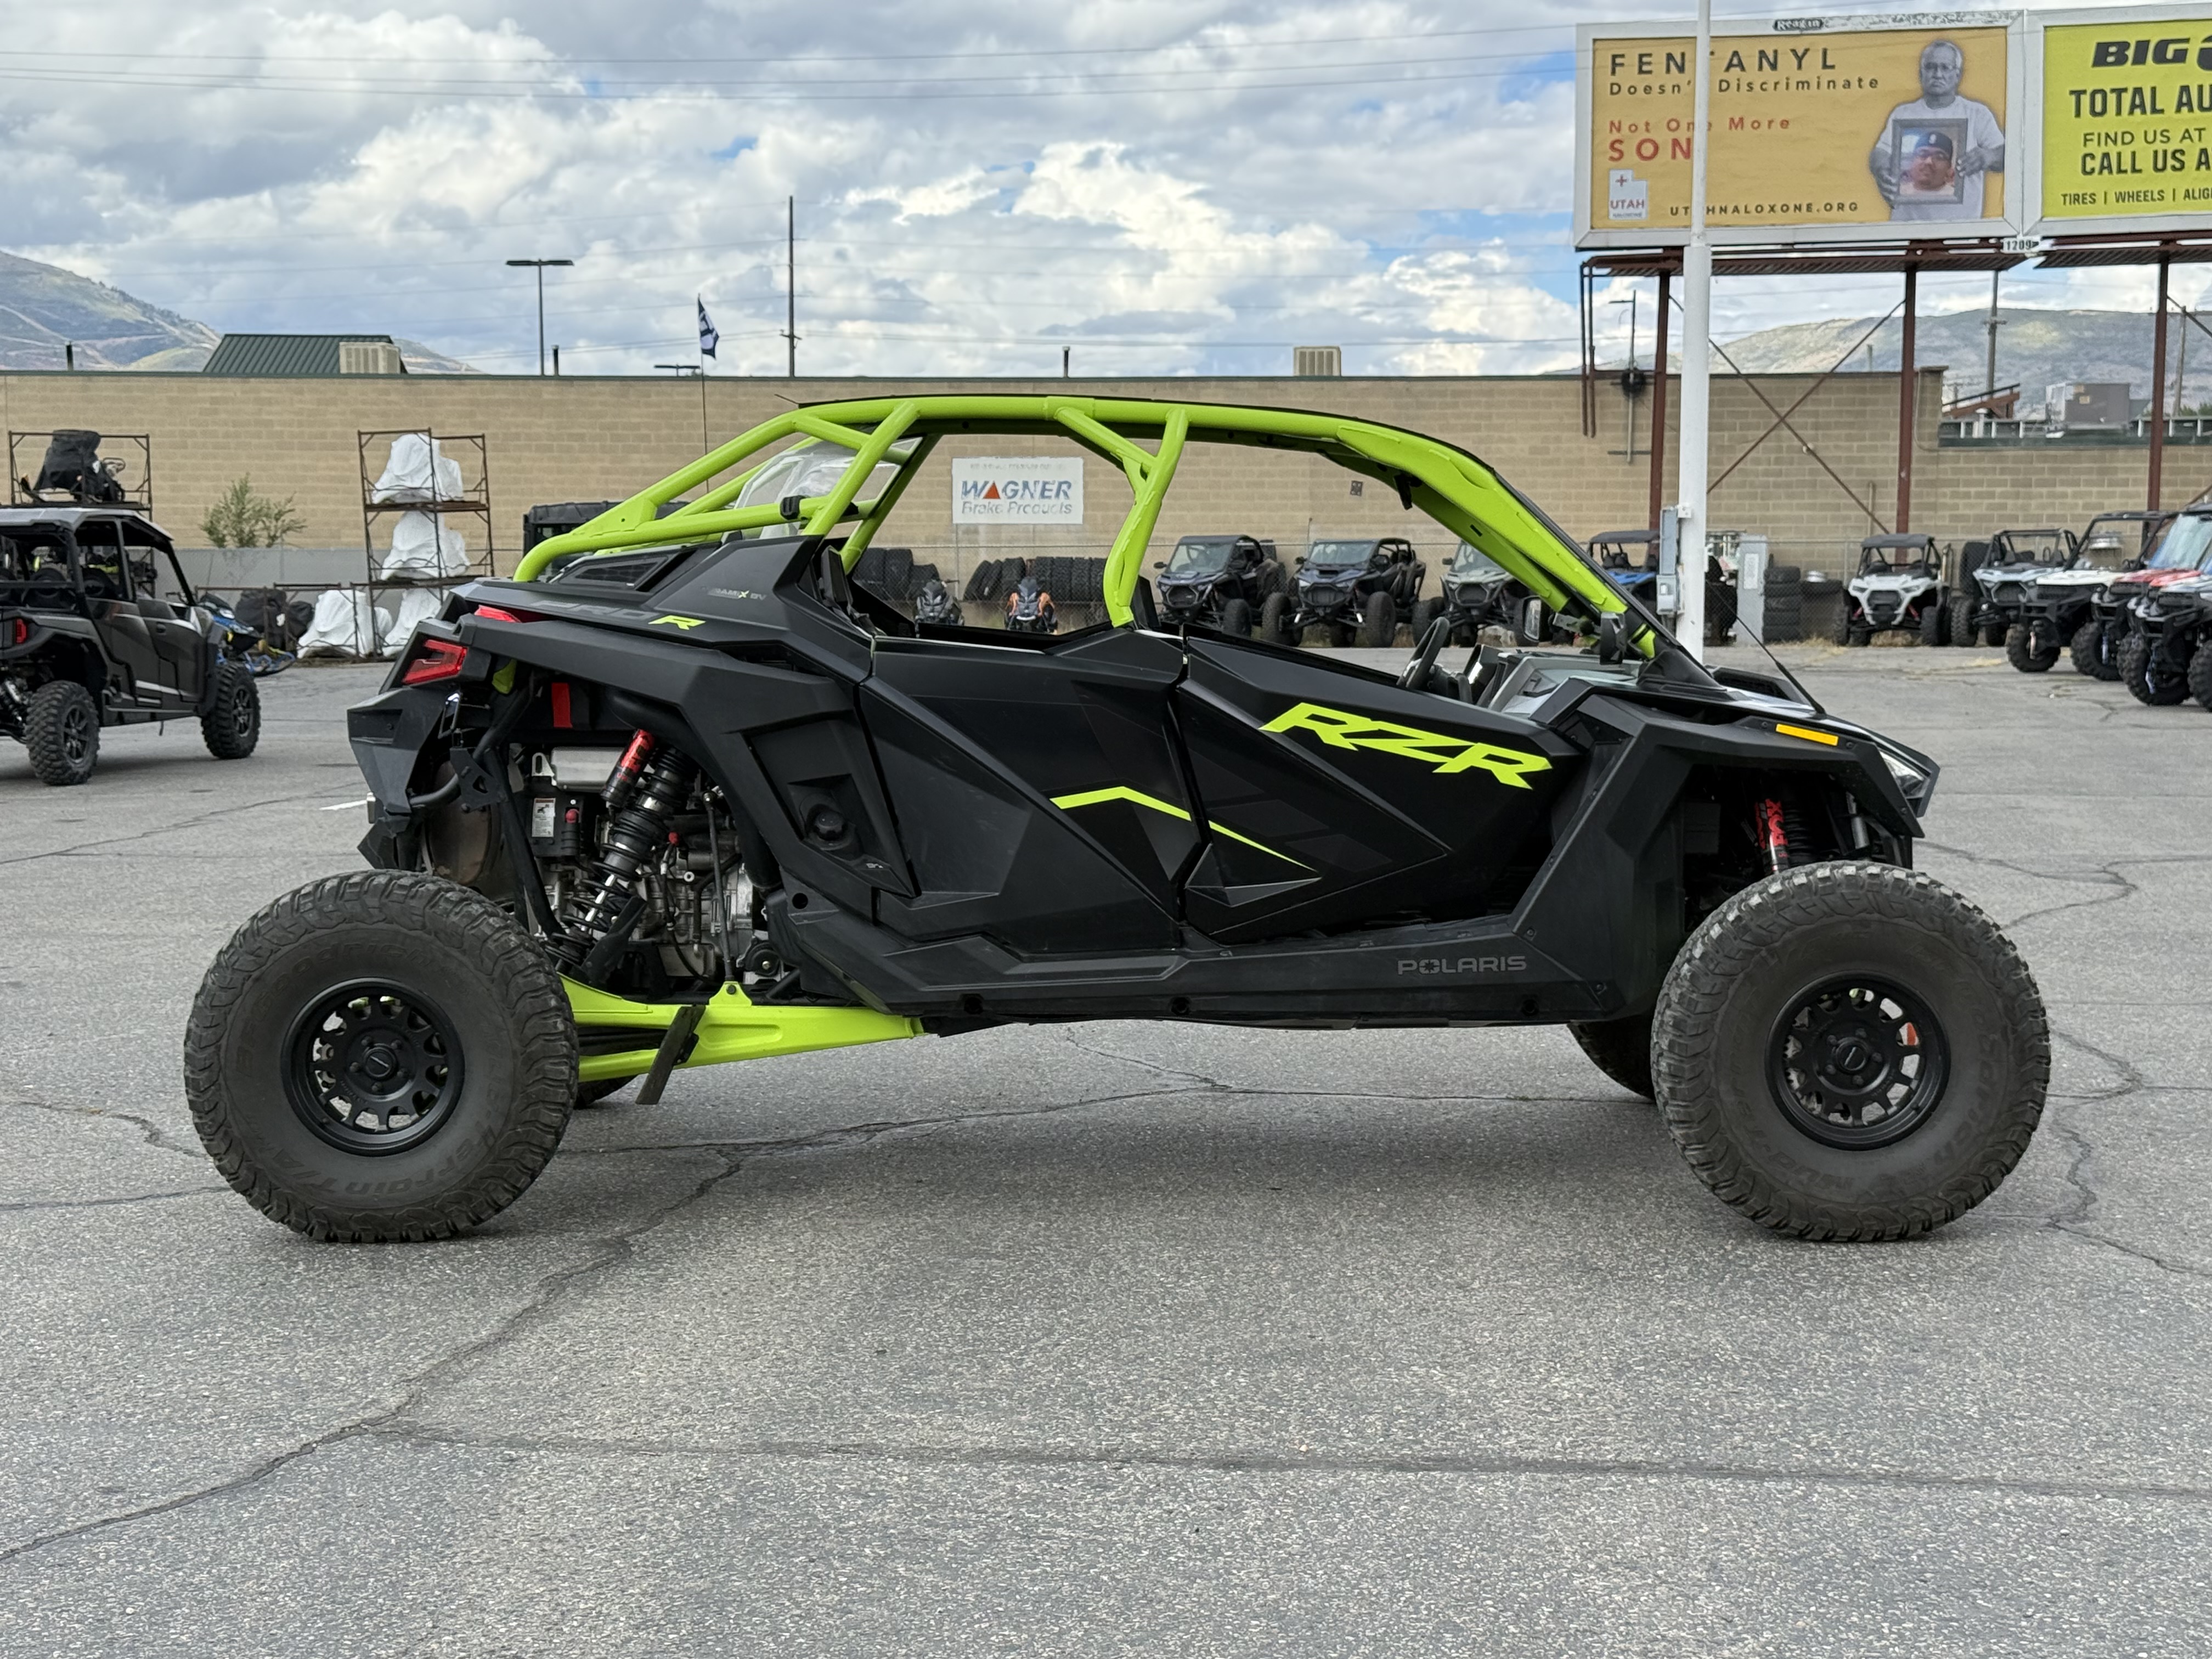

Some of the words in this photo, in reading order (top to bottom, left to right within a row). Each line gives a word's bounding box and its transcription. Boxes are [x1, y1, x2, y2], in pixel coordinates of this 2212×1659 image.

[1610, 47, 1836, 76] FENANYL
[2091, 37, 2191, 68] BIG
[1610, 79, 1692, 95] Doesn'
[1718, 76, 1879, 93] Discriminate
[2069, 86, 2165, 119] TOTAL
[1609, 119, 1651, 134] Not
[1728, 116, 1790, 131] More
[2083, 131, 2135, 148] FIND
[2143, 128, 2171, 145] US
[2179, 127, 2207, 143] AT
[1608, 137, 1691, 162] SON
[2081, 150, 2143, 176] CALL
[2152, 148, 2186, 173] US
[1610, 199, 1645, 210] UTAH
[2061, 193, 2097, 206] TIRES
[2114, 189, 2165, 204] WHEELS
[2182, 187, 2212, 201] ALIG
[1670, 201, 1859, 216] UTHNALOXONE.ORG
[2006, 239, 2032, 251] 1209
[961, 480, 1073, 500] WAGNER
[961, 501, 1003, 515] Brake
[1007, 501, 1073, 515] Products
[647, 614, 707, 630] R
[1259, 702, 1553, 789] RZR
[1765, 798, 1788, 847] FOX
[1397, 955, 1527, 975] POLARIS
